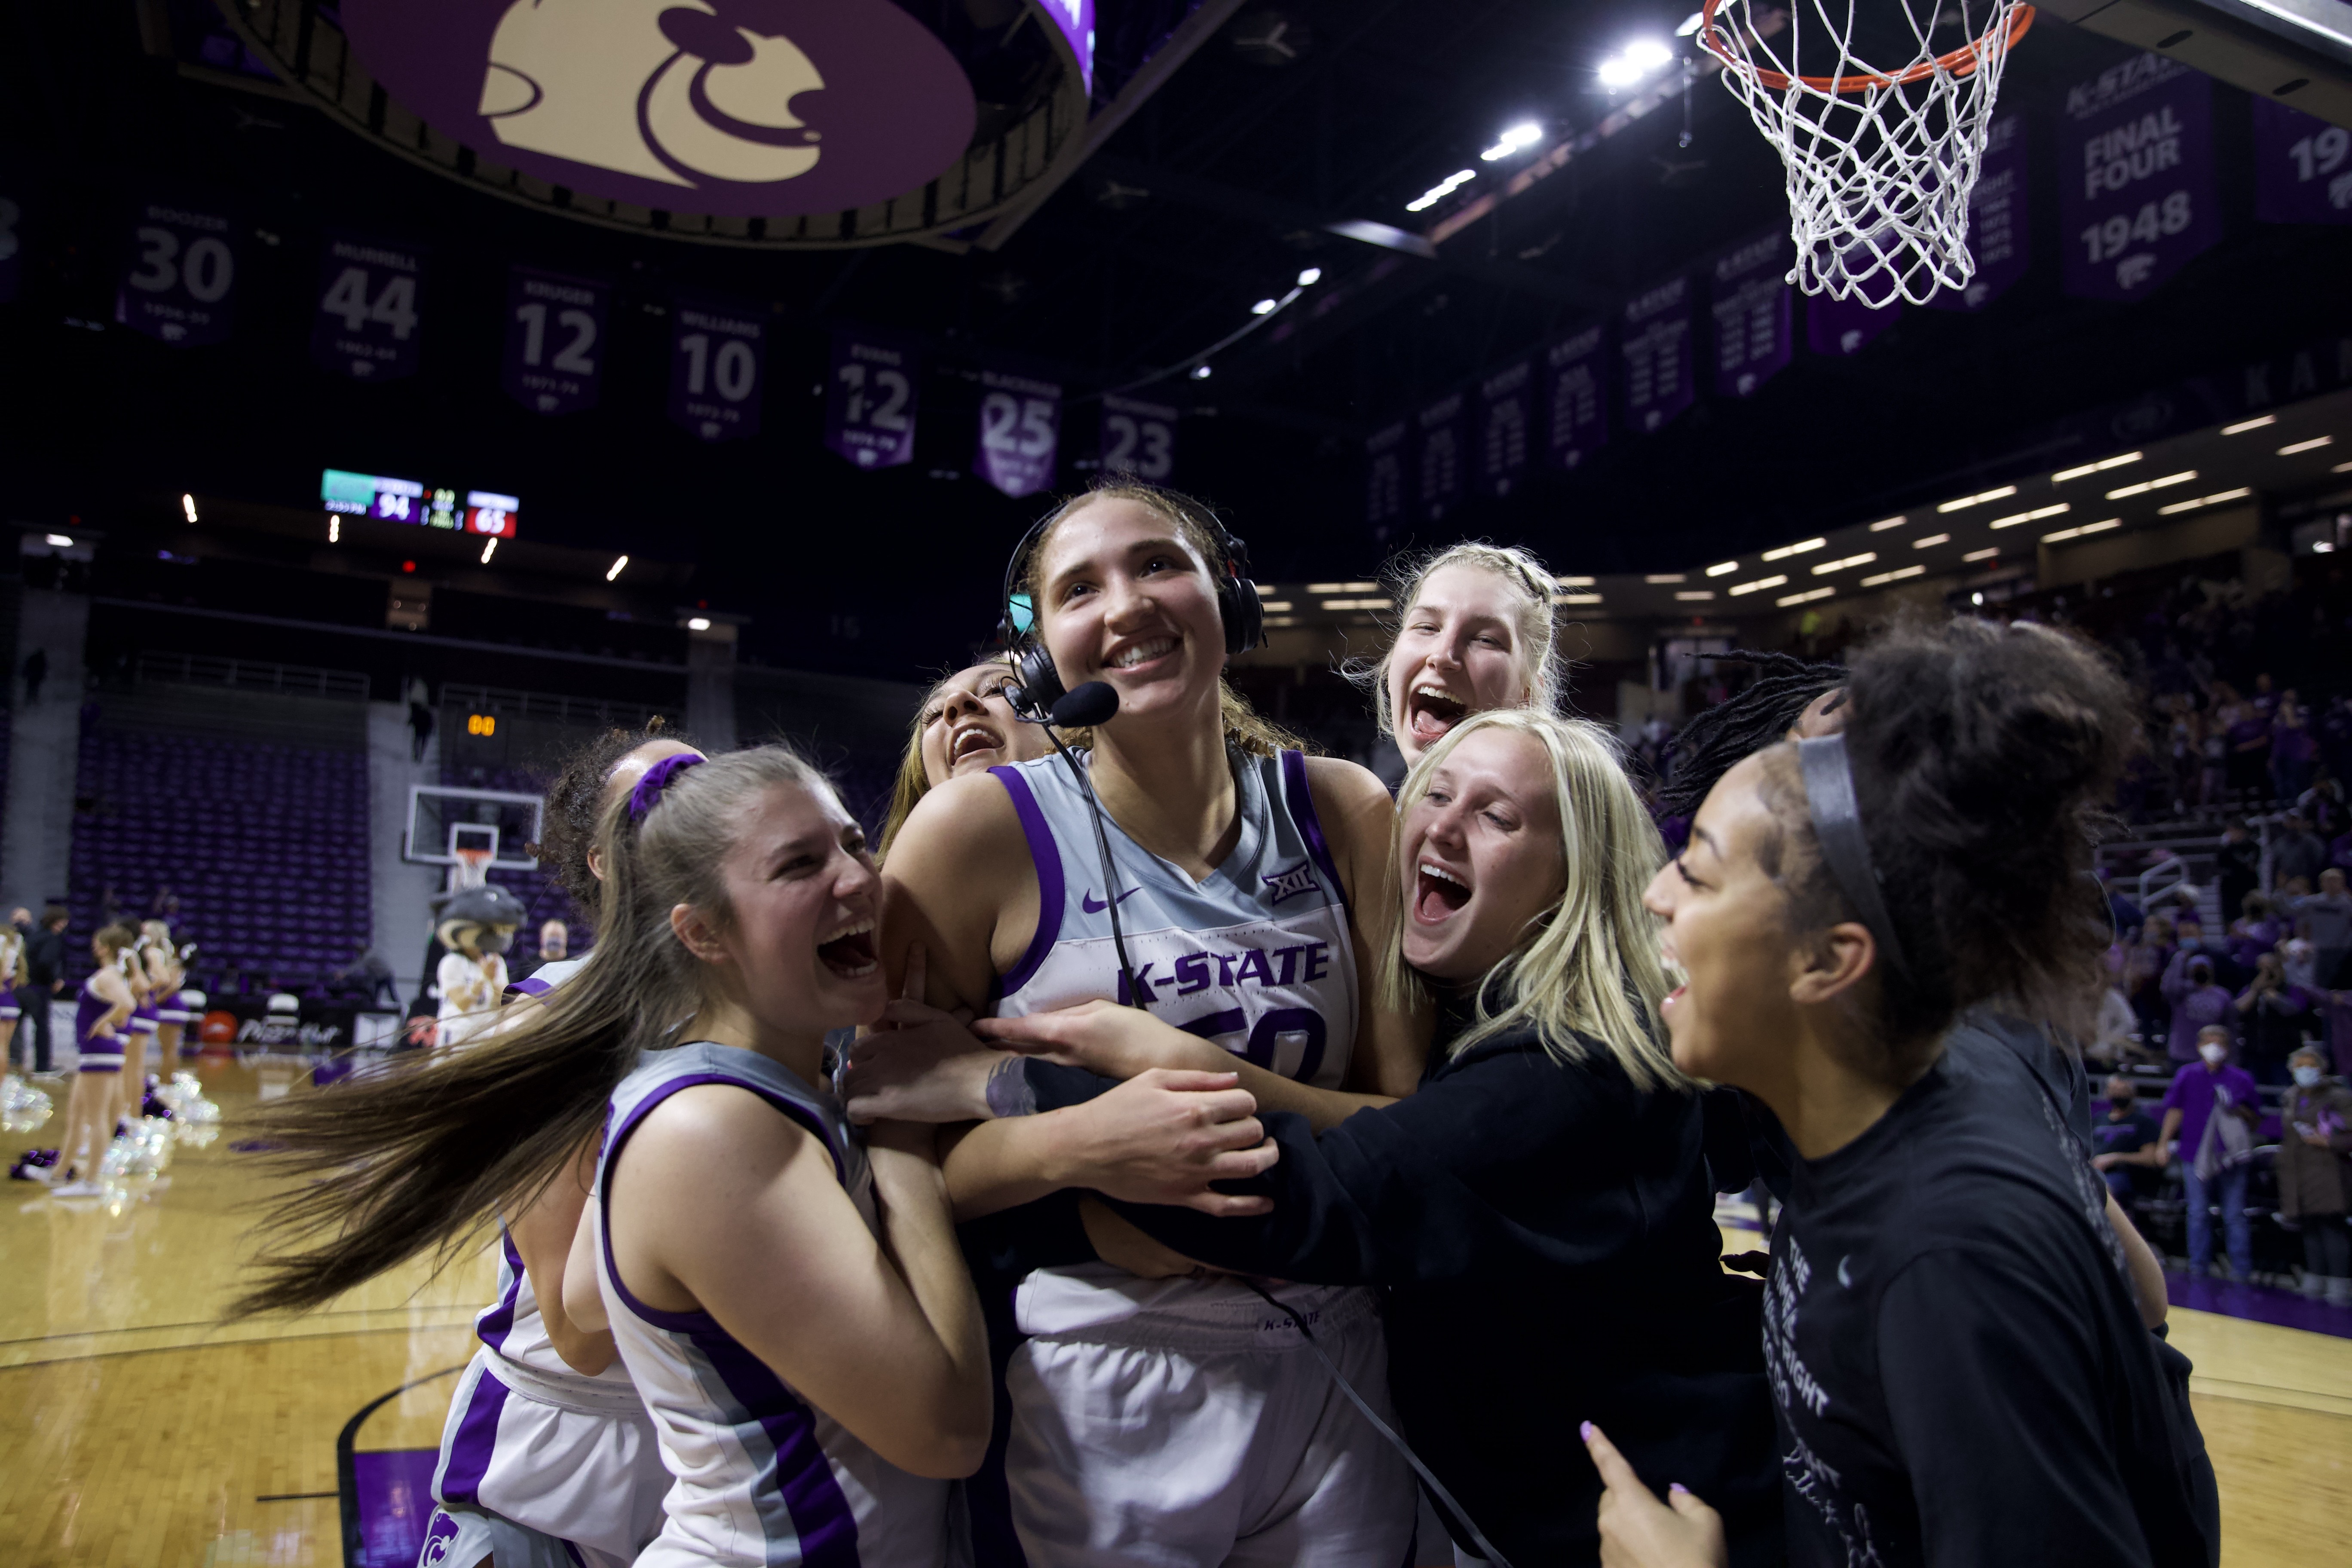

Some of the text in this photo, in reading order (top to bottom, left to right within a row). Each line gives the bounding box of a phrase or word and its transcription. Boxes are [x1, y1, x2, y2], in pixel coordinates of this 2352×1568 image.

[2085, 104, 2183, 170] FINAL
[2085, 137, 2180, 200] FOUR
[2080, 190, 2191, 264] 1948
[129, 227, 233, 303] 30
[322, 266, 418, 341] 44
[516, 303, 596, 377] 12
[679, 333, 756, 402] 10
[838, 363, 910, 432] 12
[981, 392, 1054, 457] 25
[1105, 415, 1171, 478] 23
[378, 493, 409, 521] 94
[475, 508, 506, 534] 65
[1262, 860, 1321, 906] XII
[1118, 942, 1328, 1006] K-STATE
[1789, 1234, 1811, 1295] THE
[1264, 1311, 1320, 1331] K-SATE
[1782, 1336, 1830, 1418] RIGHT
